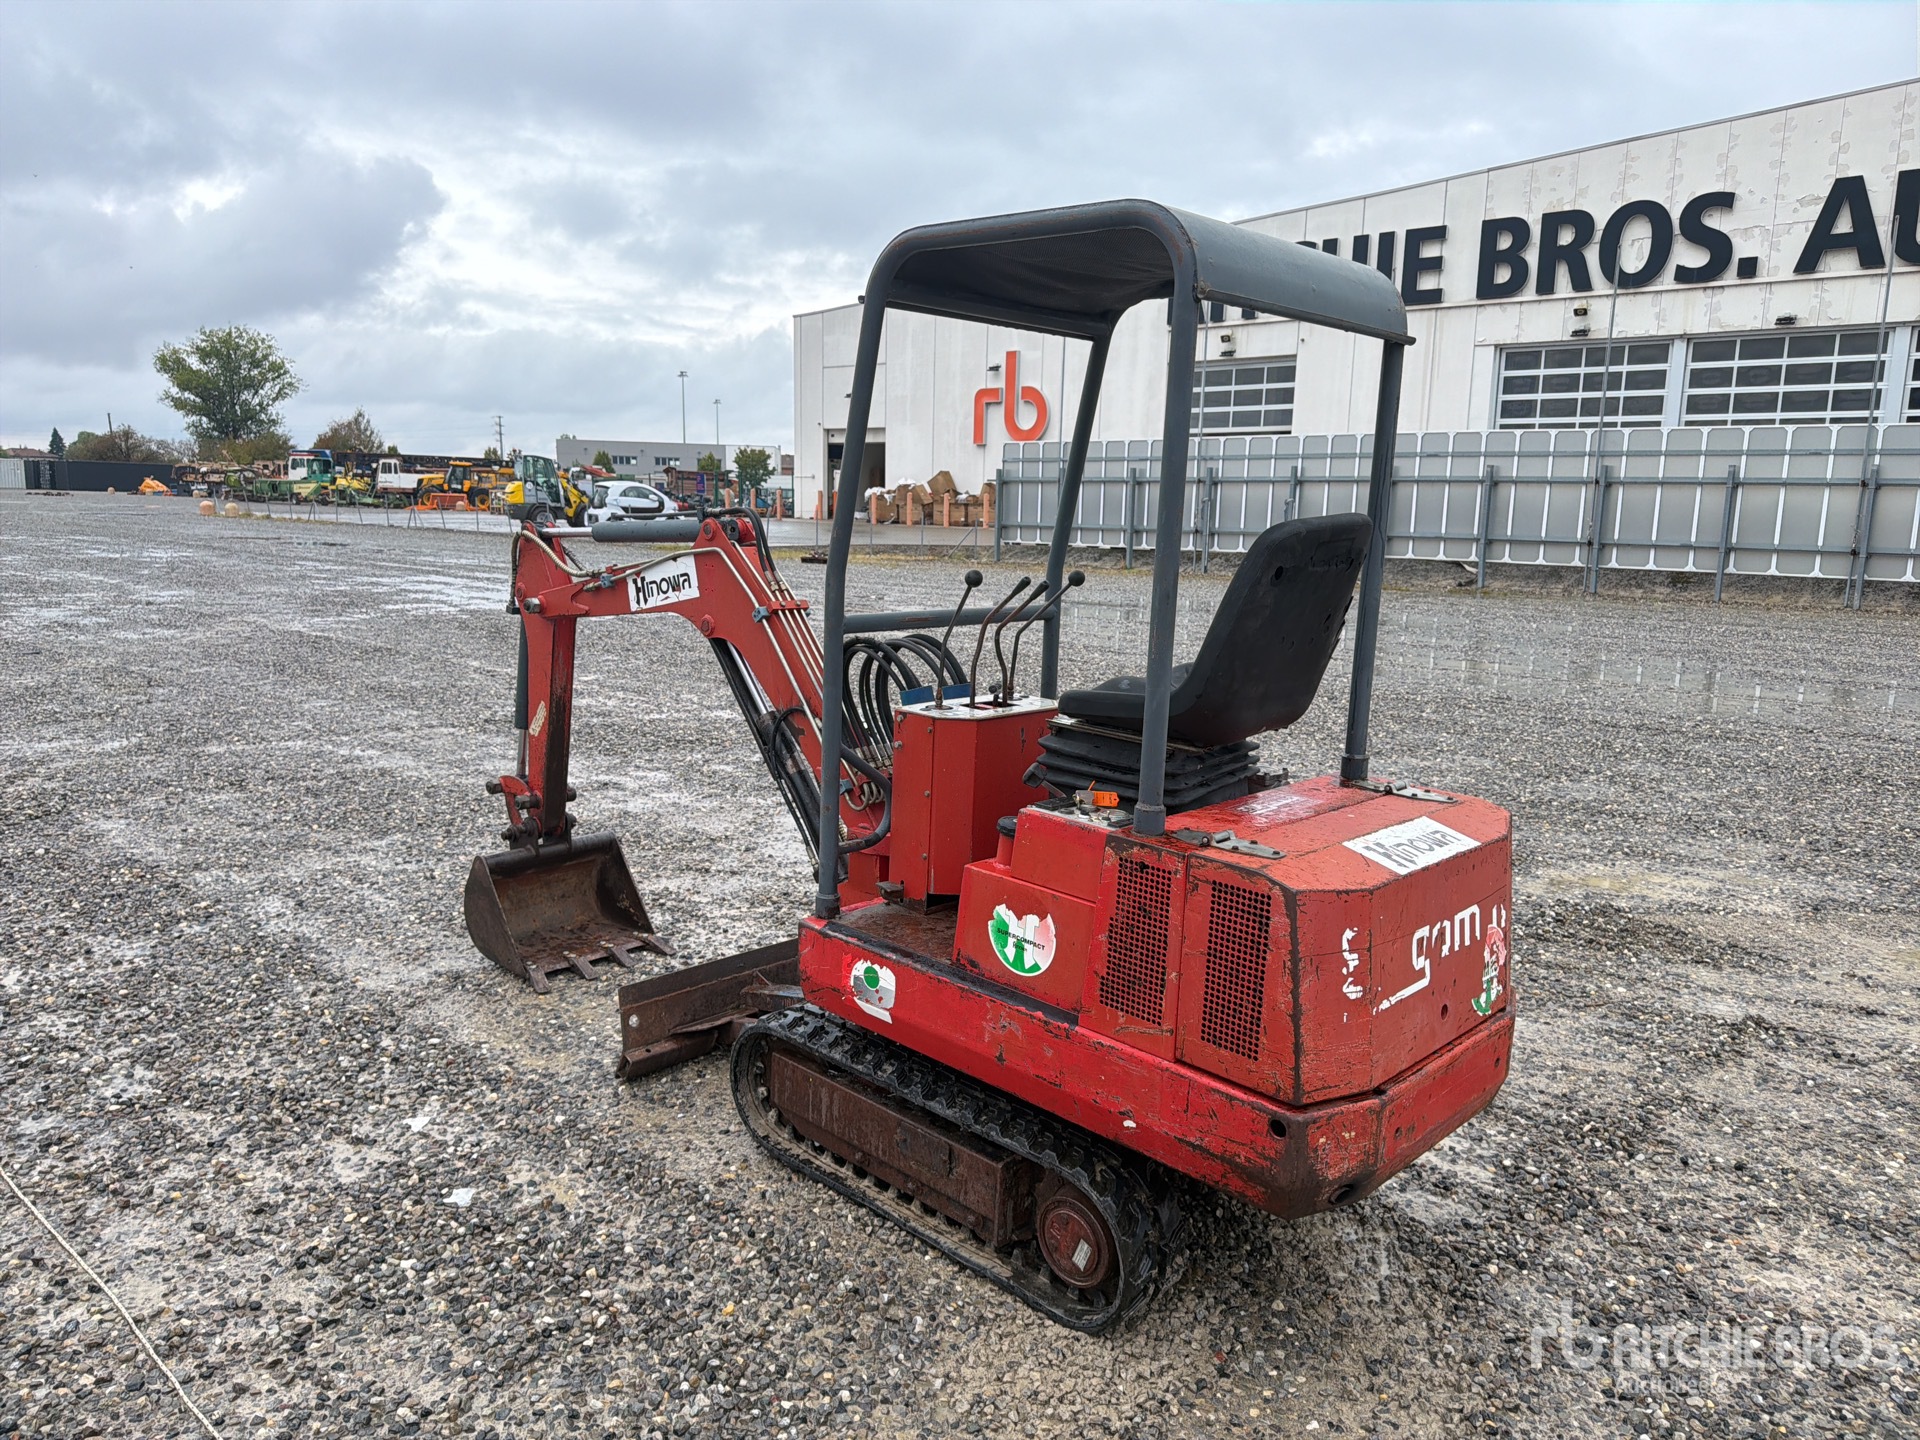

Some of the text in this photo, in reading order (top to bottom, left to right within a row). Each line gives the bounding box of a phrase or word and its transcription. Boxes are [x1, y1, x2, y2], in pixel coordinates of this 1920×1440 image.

[1476, 191, 1759, 300] BROS.
[973, 350, 1049, 446] rb
[996, 927, 1046, 951] SUPERCOMPACT
